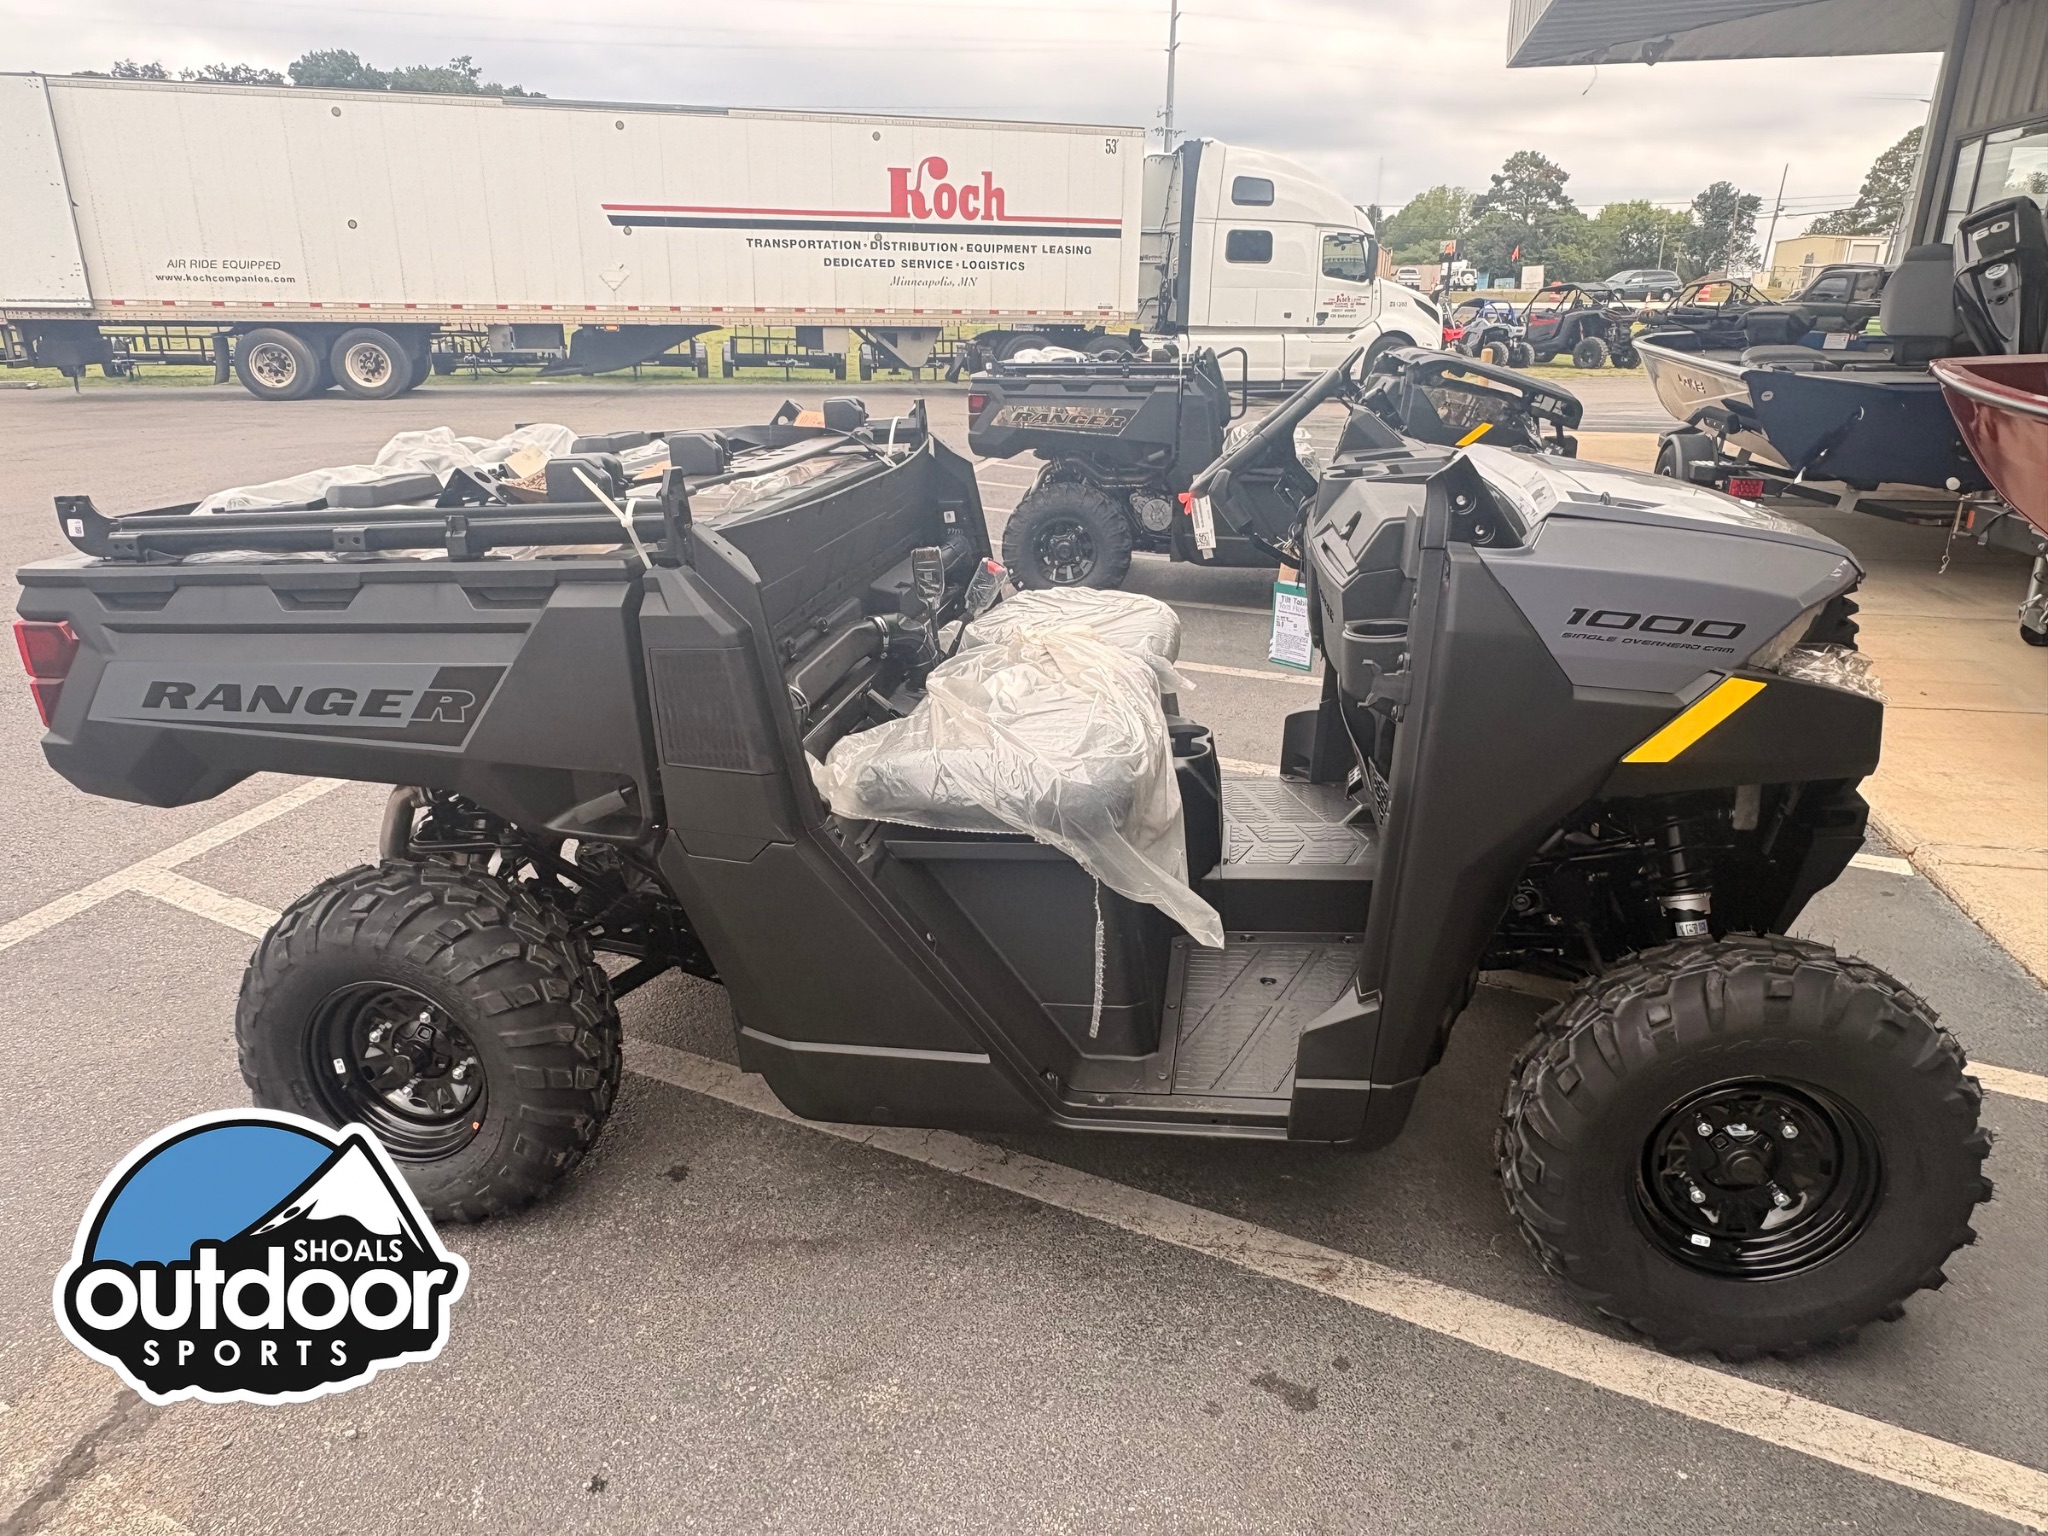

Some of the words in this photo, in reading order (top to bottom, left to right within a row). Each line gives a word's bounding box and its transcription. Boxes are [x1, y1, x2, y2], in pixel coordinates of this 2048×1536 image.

[887, 156, 1005, 221] Koch
[746, 237, 861, 251] TRANSPORTATION
[870, 240, 958, 253] DISTRIBUTION
[966, 243, 1038, 255] EQUIPMENT
[1041, 244, 1092, 255] LEASING
[167, 259, 186, 269] AIR
[190, 259, 218, 269] RIDE
[222, 260, 281, 270] EQUIPPED
[823, 257, 896, 268] DEDICATED
[901, 258, 953, 269] SERVICE
[962, 260, 1026, 271] LOGISTICS
[1012, 412, 1127, 428] RANGER
[1566, 608, 1746, 640] 1000
[1561, 632, 1617, 643] SINGLE
[1622, 638, 1701, 650] OVERHEAD
[1702, 644, 1735, 654] CAM
[142, 681, 476, 723] RANGER
